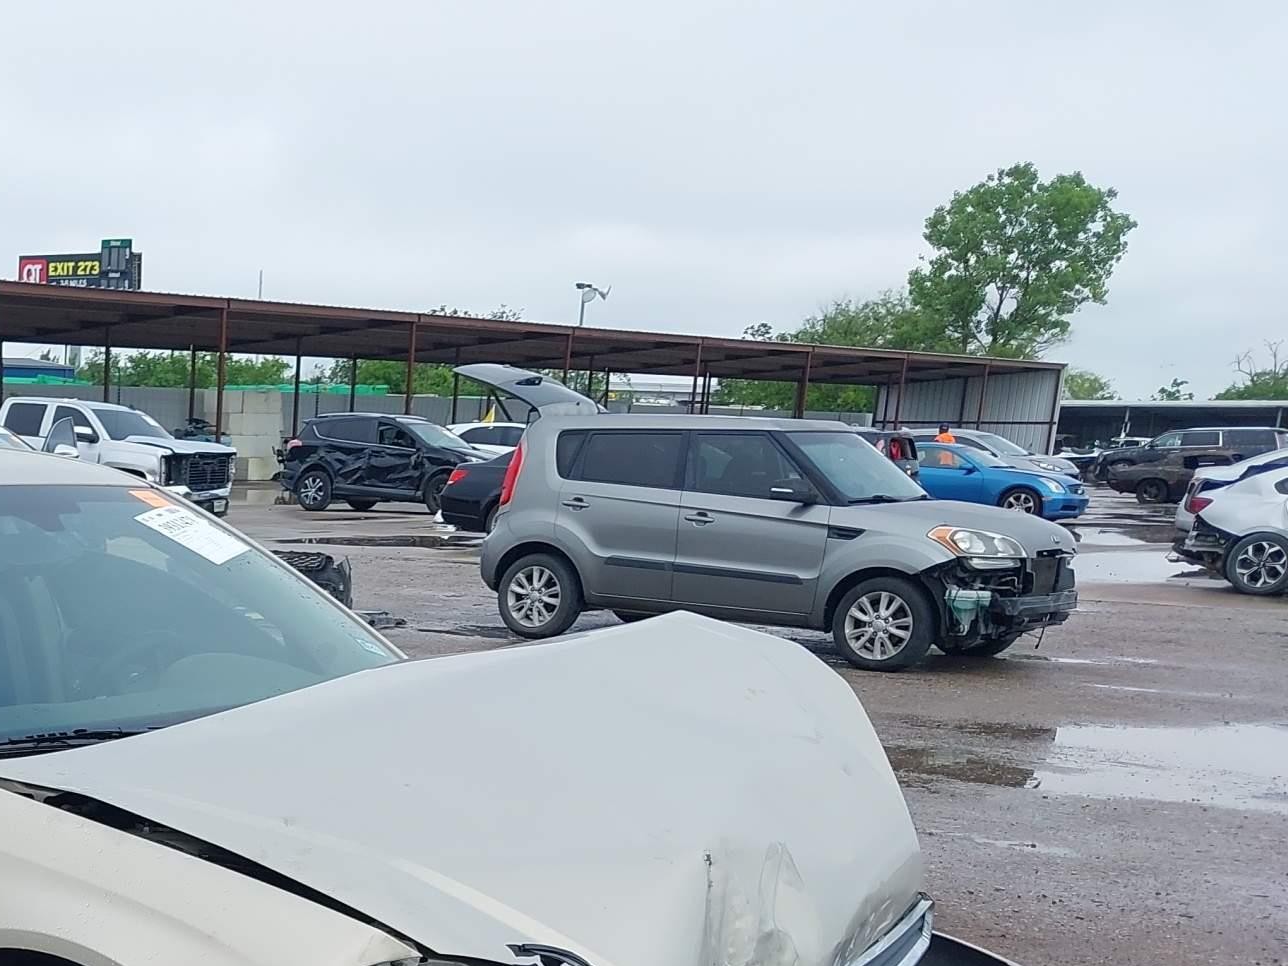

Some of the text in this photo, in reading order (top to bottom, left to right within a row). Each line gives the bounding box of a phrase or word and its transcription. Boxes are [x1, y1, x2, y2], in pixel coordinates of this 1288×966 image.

[23, 264, 42, 284] QT
[48, 261, 75, 276] EXIT
[77, 260, 100, 275] 273
